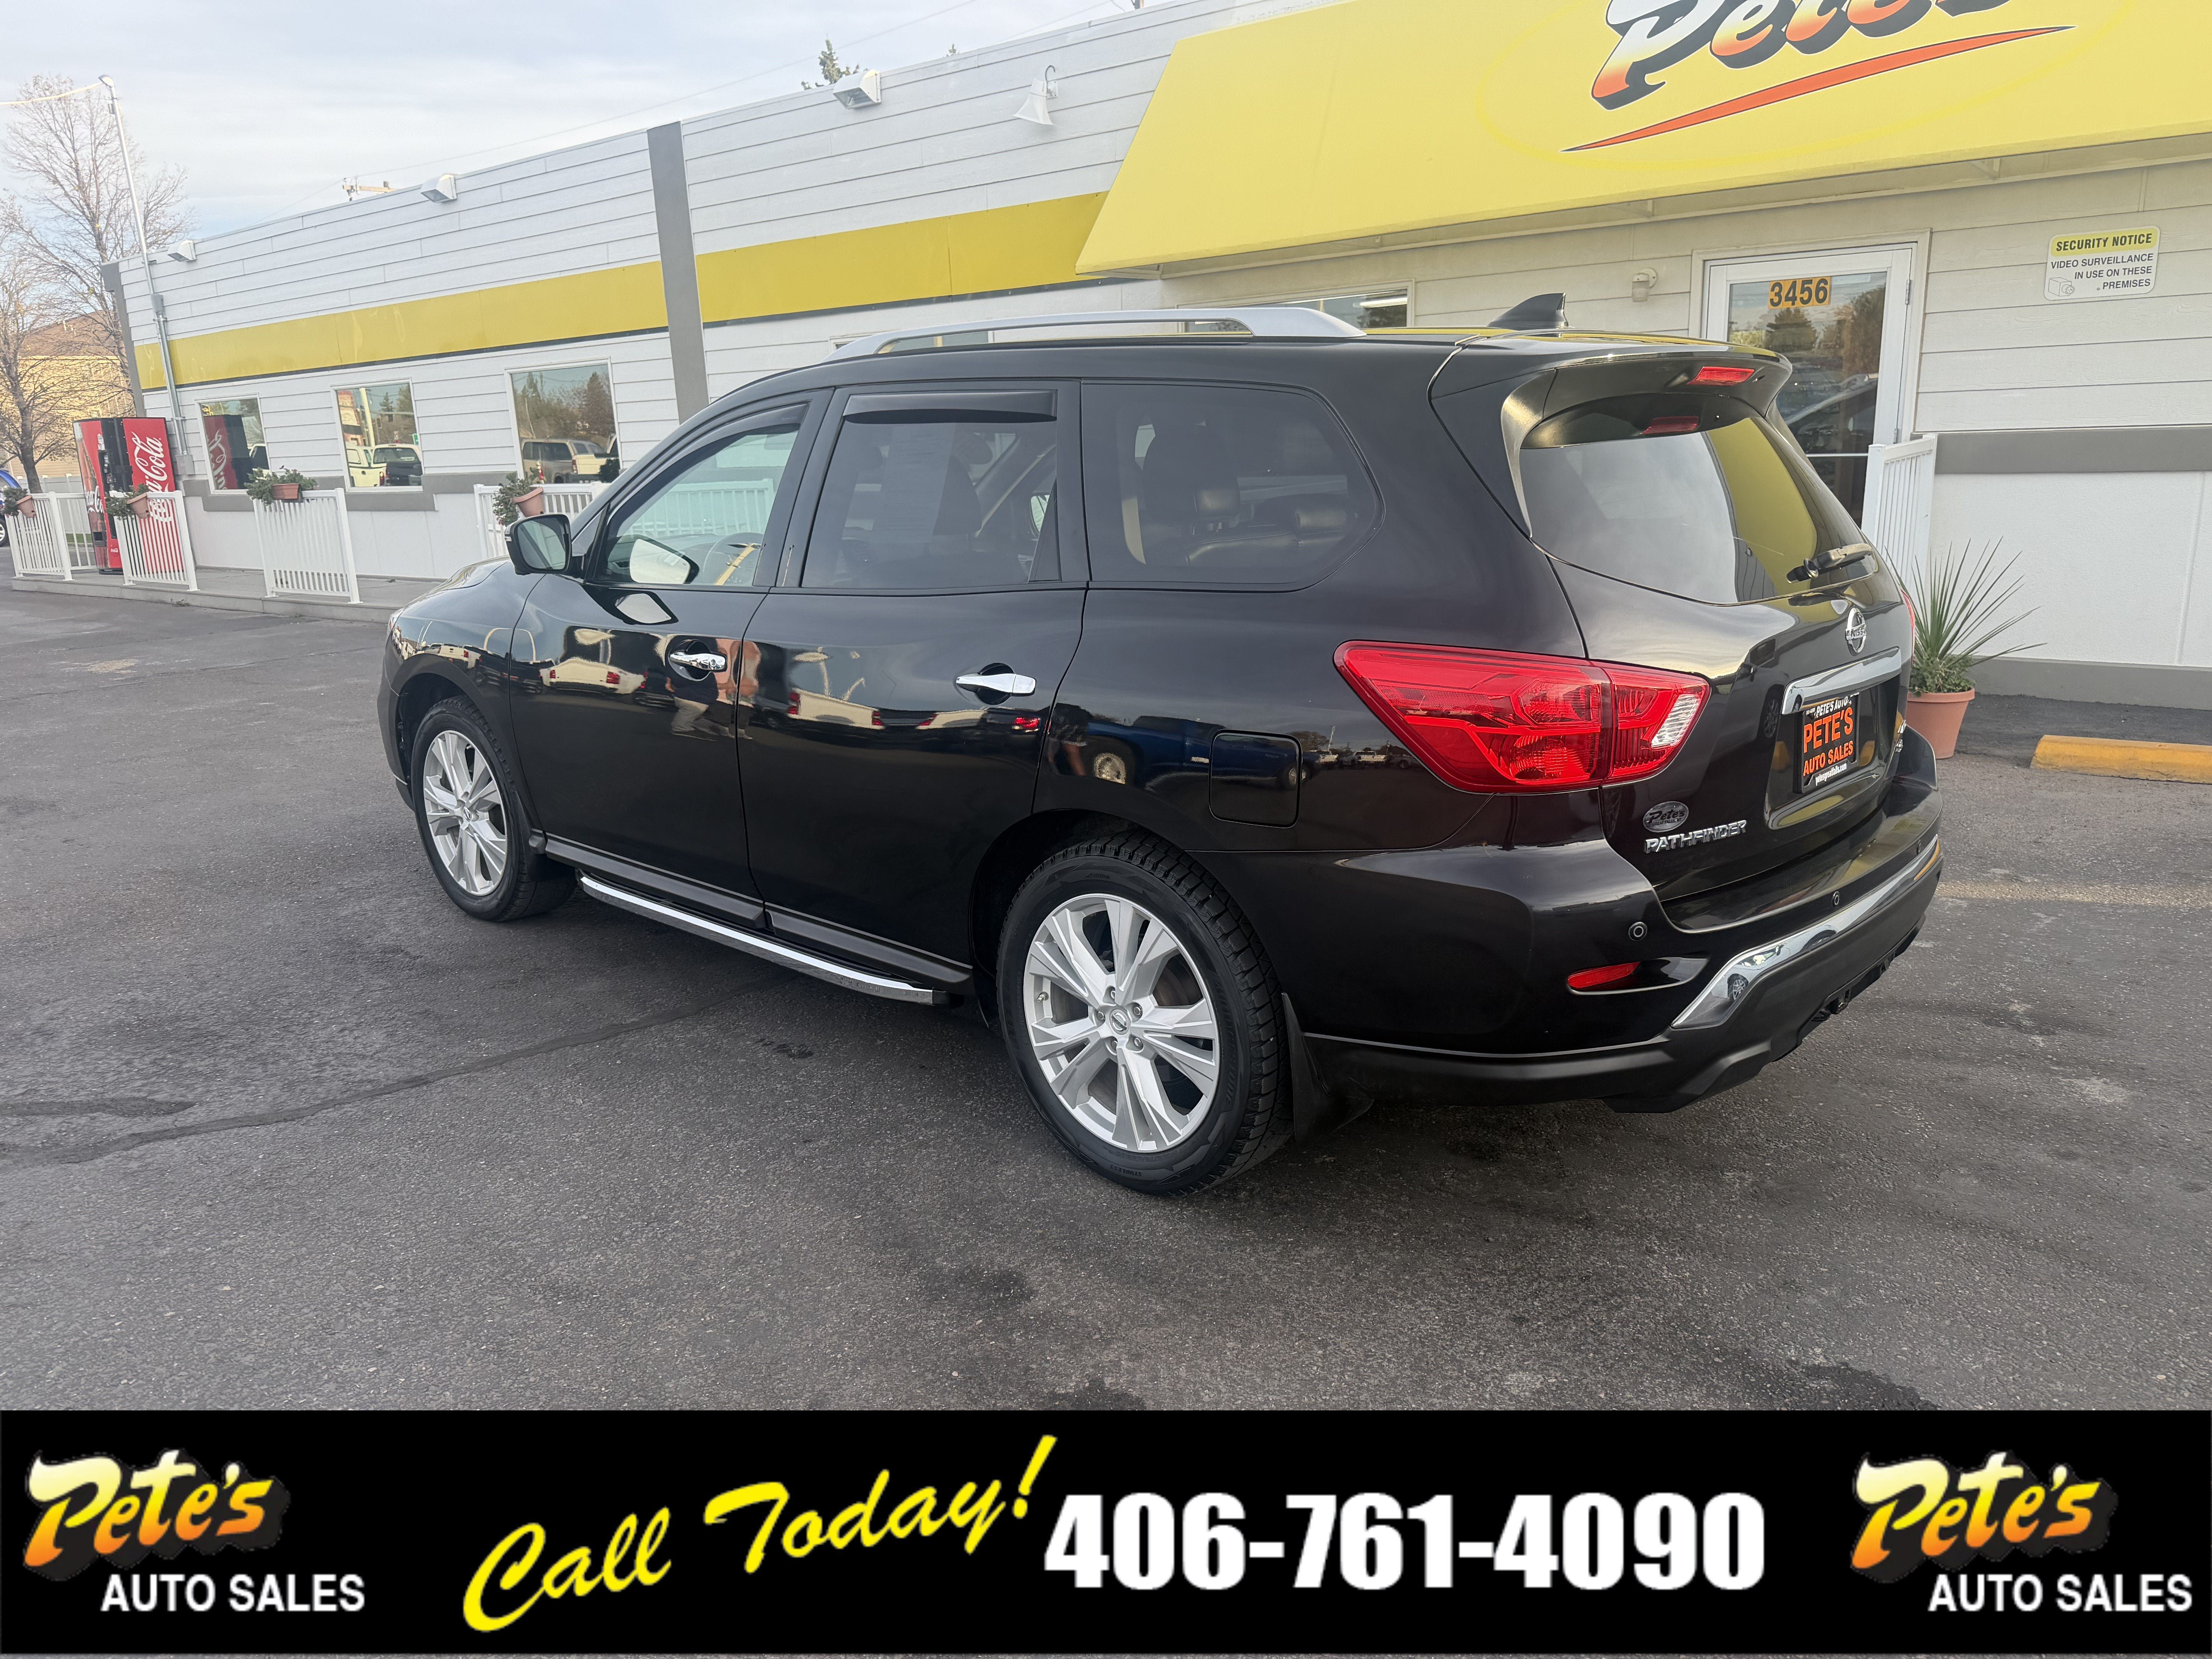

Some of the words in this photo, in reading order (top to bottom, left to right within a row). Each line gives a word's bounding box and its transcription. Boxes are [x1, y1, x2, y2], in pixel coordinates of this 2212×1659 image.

[2056, 237, 2109, 251] SECURITY
[2112, 233, 2152, 246] NOTICE
[2051, 259, 2078, 269] VIDEO
[2081, 253, 2154, 266] SURVEILLANCE
[2086, 270, 2104, 278] USE
[2106, 269, 2119, 277] ON
[2122, 266, 2152, 275] THESE
[1769, 278, 1828, 307] 3456
[2102, 278, 2150, 290] PREMISES
[1816, 701, 1834, 716] PETE'S
[1834, 696, 1848, 711] AUTO
[1803, 707, 1853, 753] PETE'S
[1803, 752, 1826, 776] AUTO
[1828, 740, 1853, 764] SALES
[1649, 809, 1686, 823] Pete's
[1644, 820, 1747, 853] PATHFINDER
